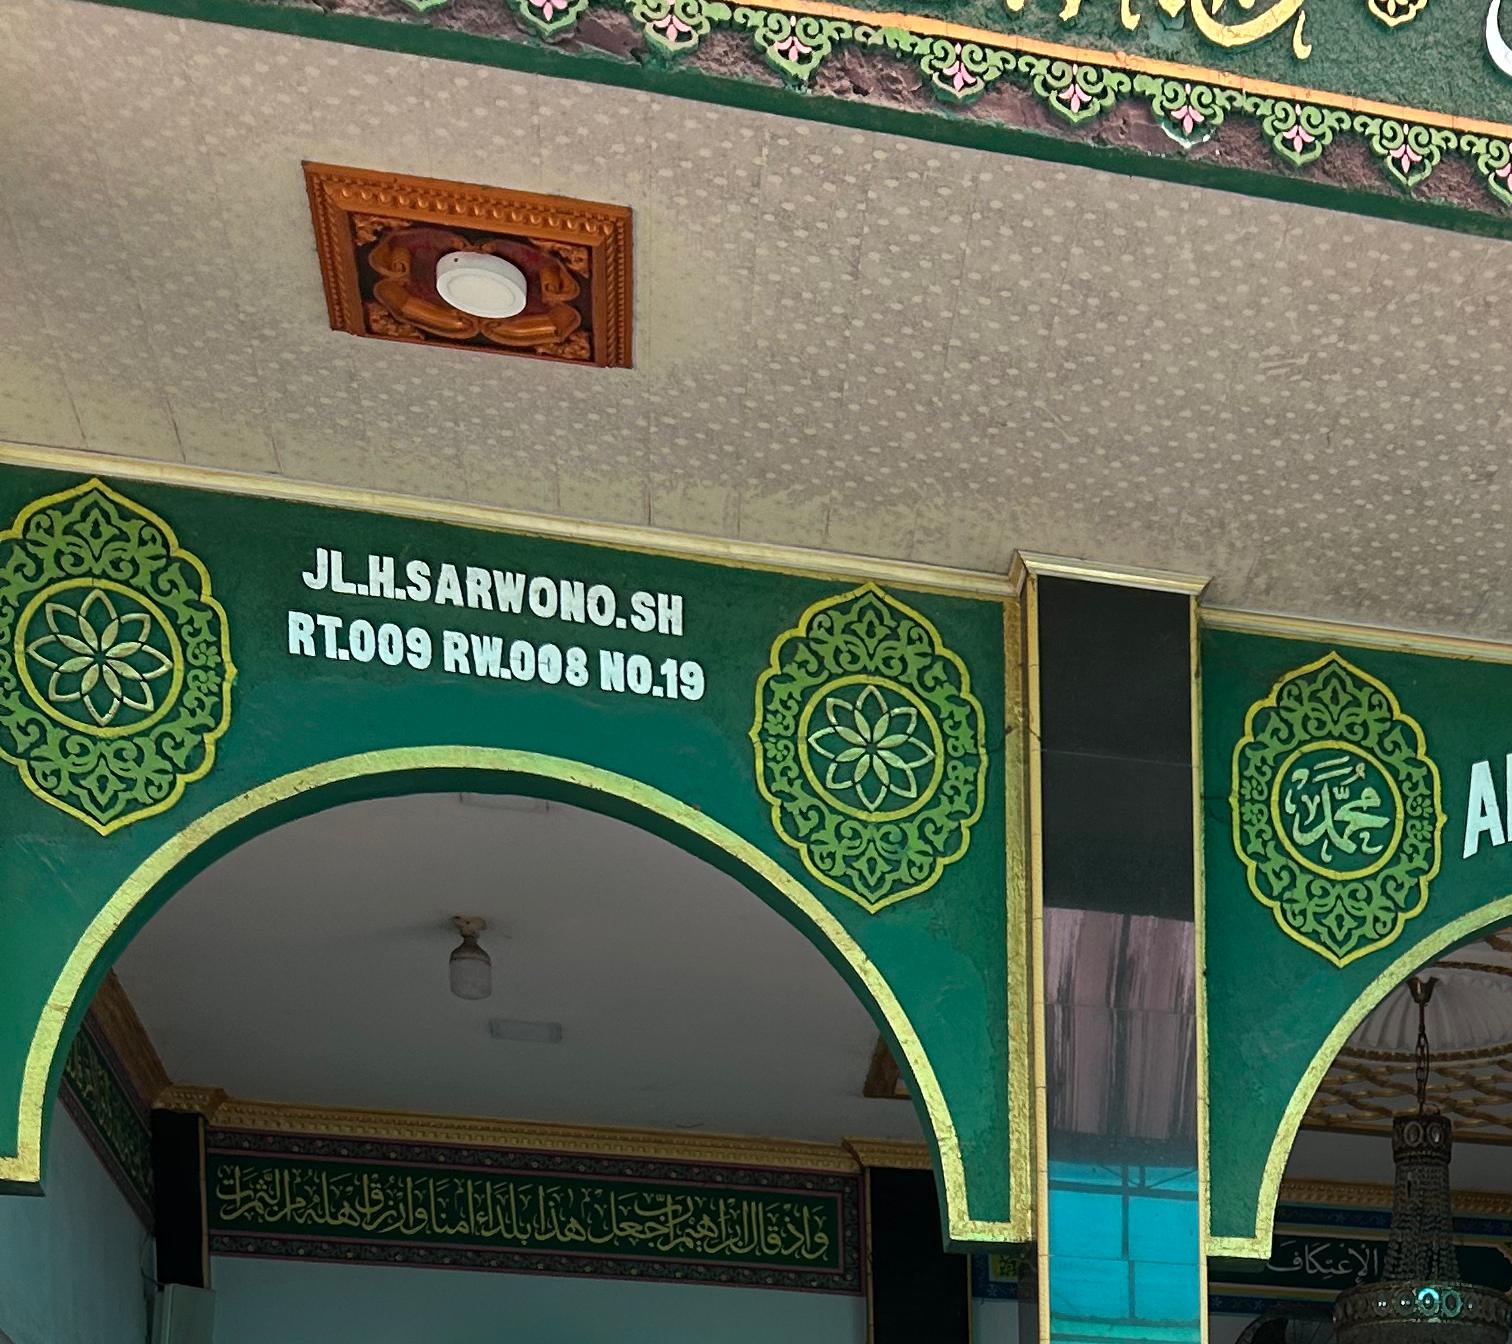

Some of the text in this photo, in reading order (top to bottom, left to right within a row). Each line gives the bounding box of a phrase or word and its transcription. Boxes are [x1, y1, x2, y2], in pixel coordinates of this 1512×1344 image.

[302, 547, 685, 637] JL.H.SARWONO.SH
[287, 611, 706, 702] RT.009 RW.008 NO.19
